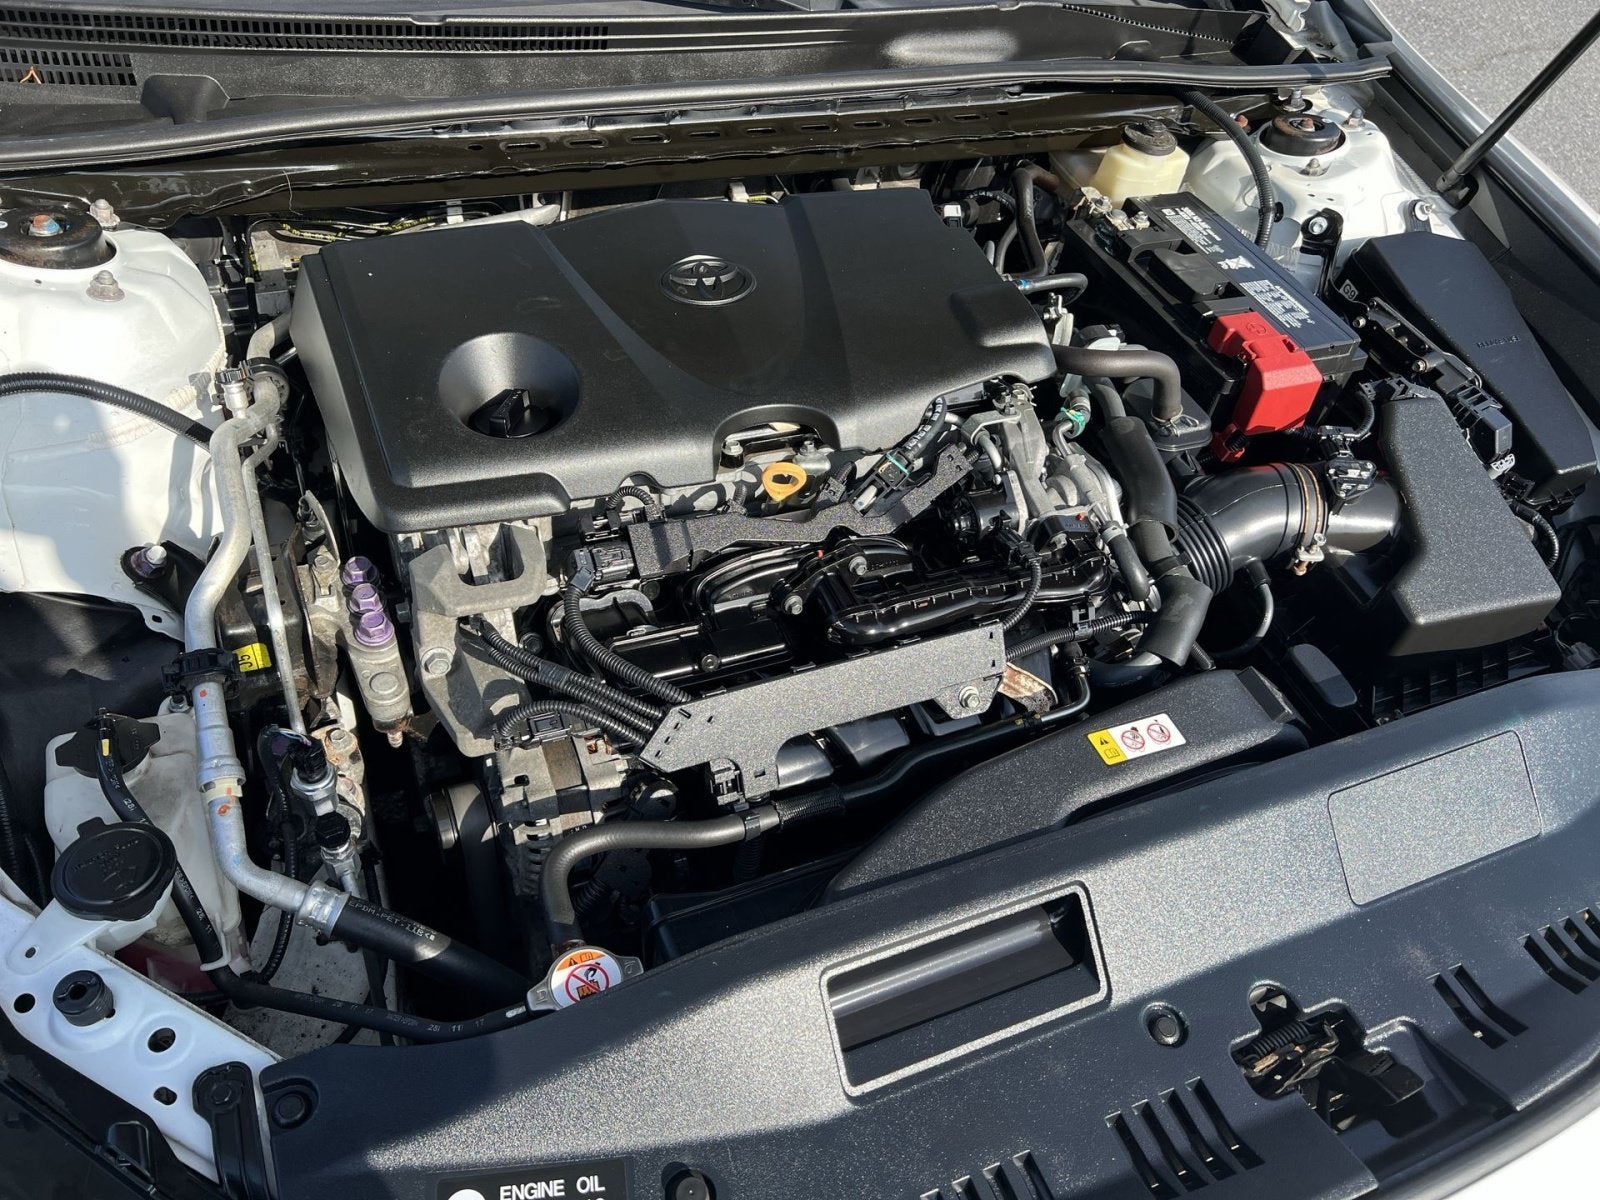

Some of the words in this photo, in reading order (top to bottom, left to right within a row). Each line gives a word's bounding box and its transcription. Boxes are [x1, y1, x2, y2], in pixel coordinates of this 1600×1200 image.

[1343, 284, 1356, 300] G9
[239, 654, 253, 668] J5
[500, 1179, 566, 1200] ENGINE
[576, 1175, 606, 1194] OIL
